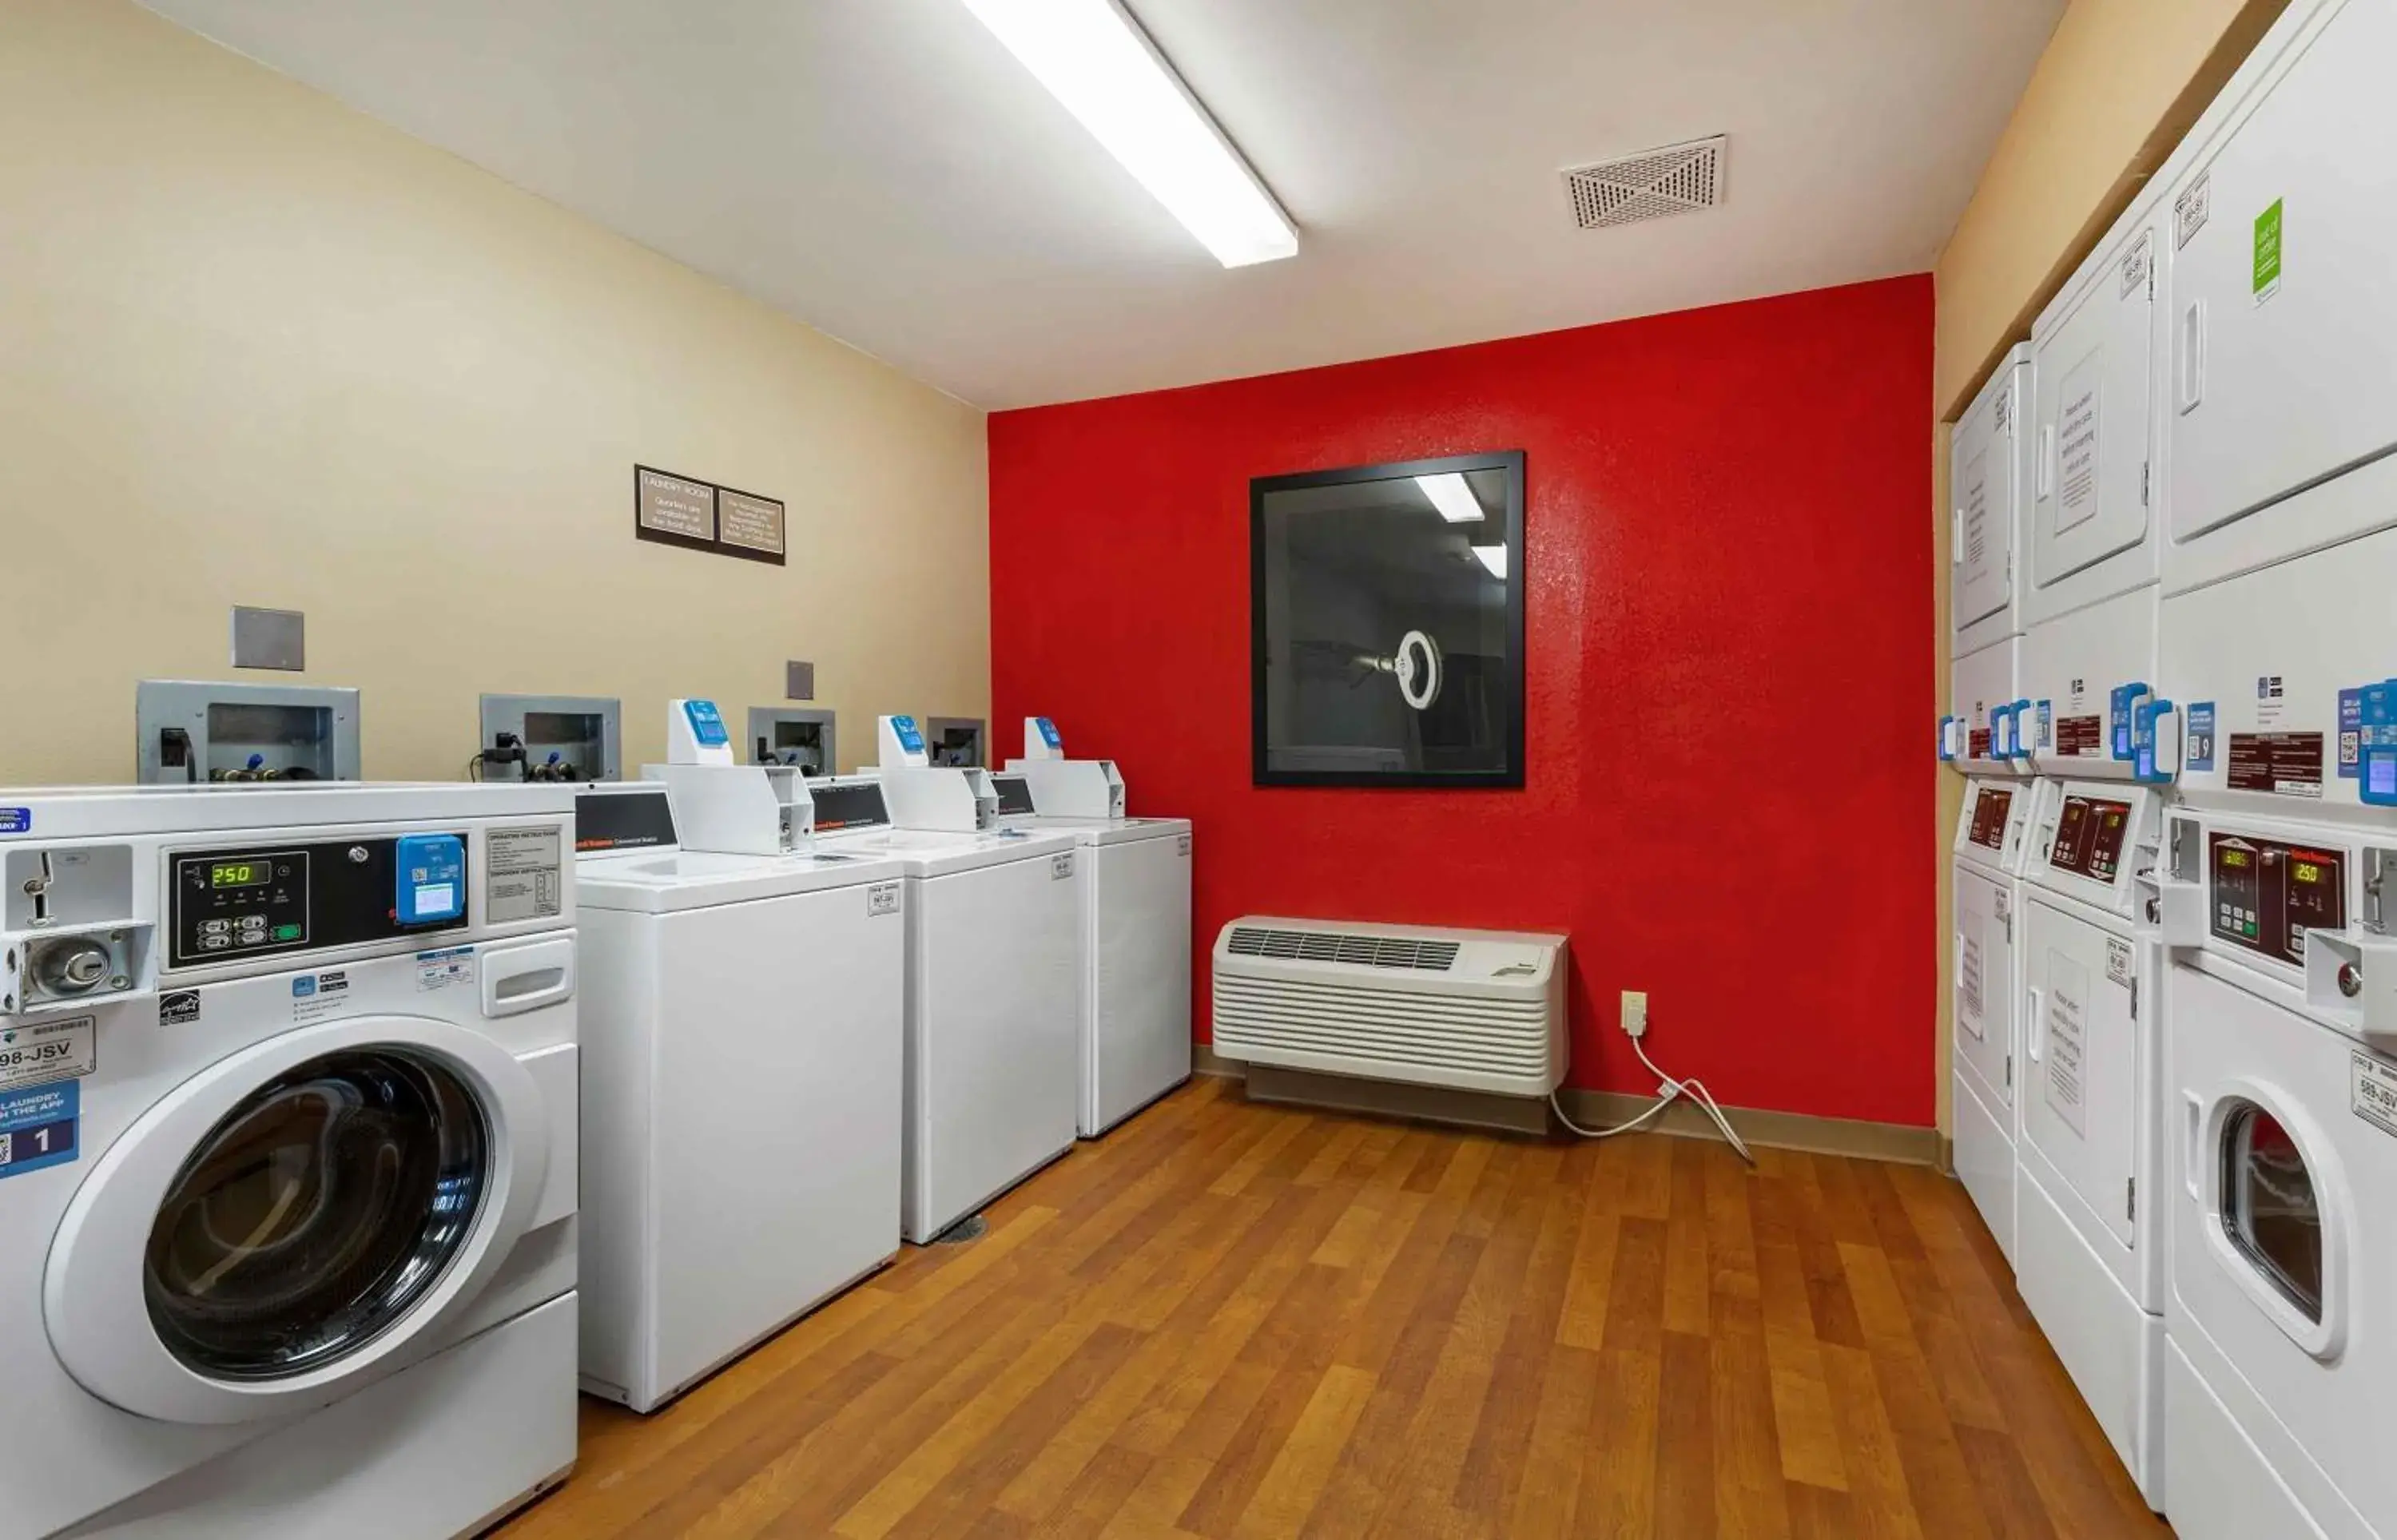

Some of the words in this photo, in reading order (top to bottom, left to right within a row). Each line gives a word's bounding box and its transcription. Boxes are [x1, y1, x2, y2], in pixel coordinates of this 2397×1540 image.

[2203, 737, 2209, 757] 9
[214, 867, 250, 883] 250
[1, 1091, 60, 1109] LAUNDRY
[12, 1105, 36, 1116] THE
[40, 1099, 64, 1111] APP
[34, 1128, 49, 1152] 1
